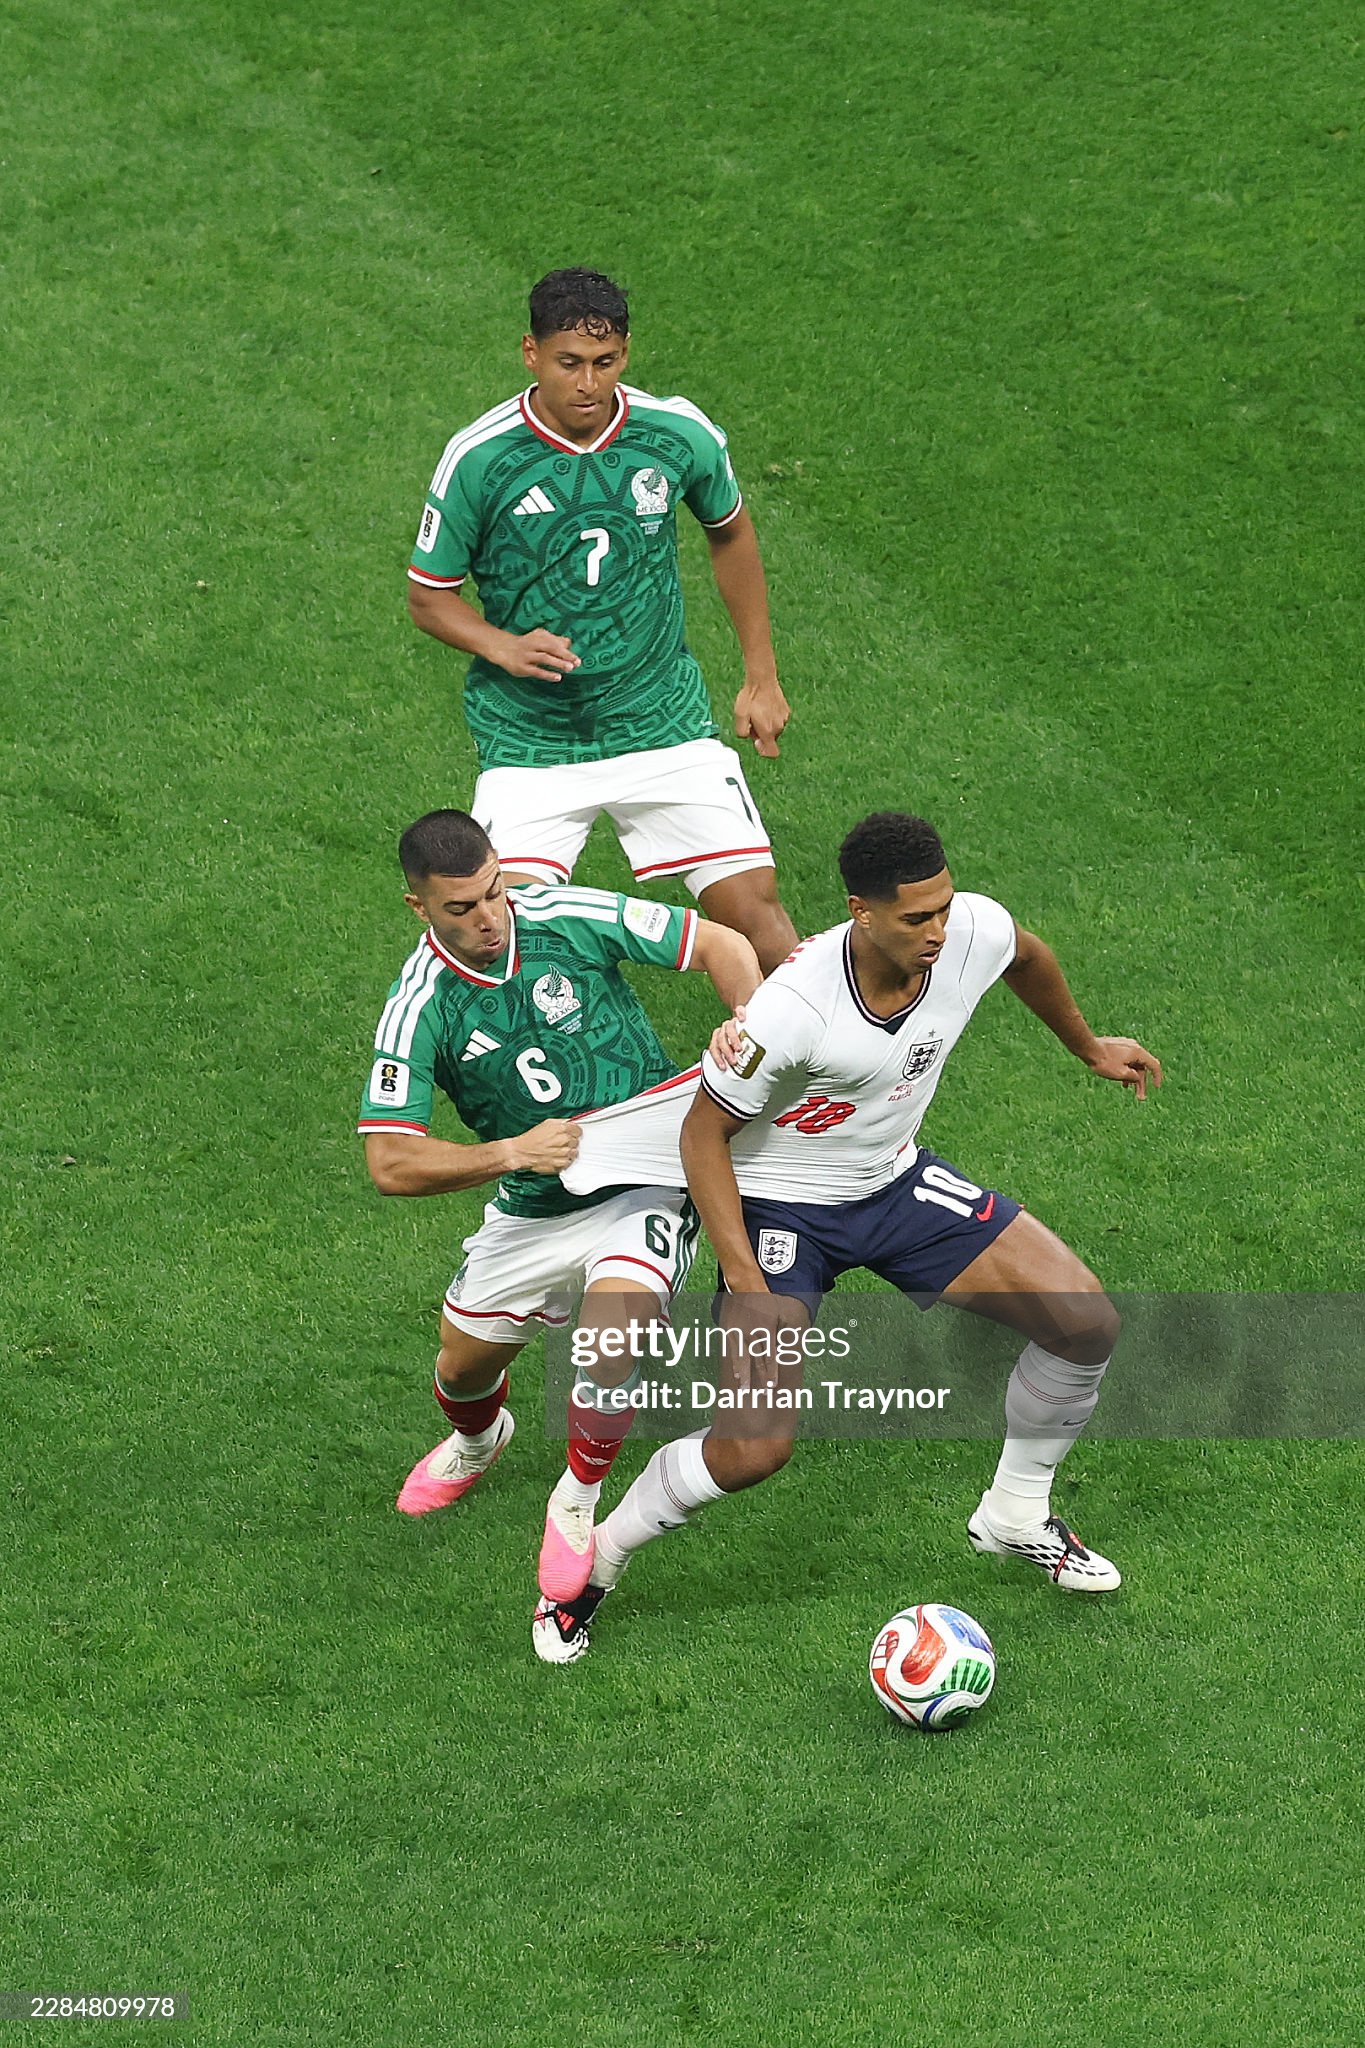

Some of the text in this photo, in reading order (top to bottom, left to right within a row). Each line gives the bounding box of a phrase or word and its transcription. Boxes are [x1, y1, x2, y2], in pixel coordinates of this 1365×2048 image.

[637, 504, 667, 513] MEXICO
[579, 527, 610, 587] 7
[725, 777, 756, 829] 7
[548, 1001, 579, 1022] MEXICO
[515, 1047, 562, 1103] 6
[771, 1096, 857, 1134] 10
[914, 1165, 984, 1218] 10
[645, 1214, 671, 1258] 6
